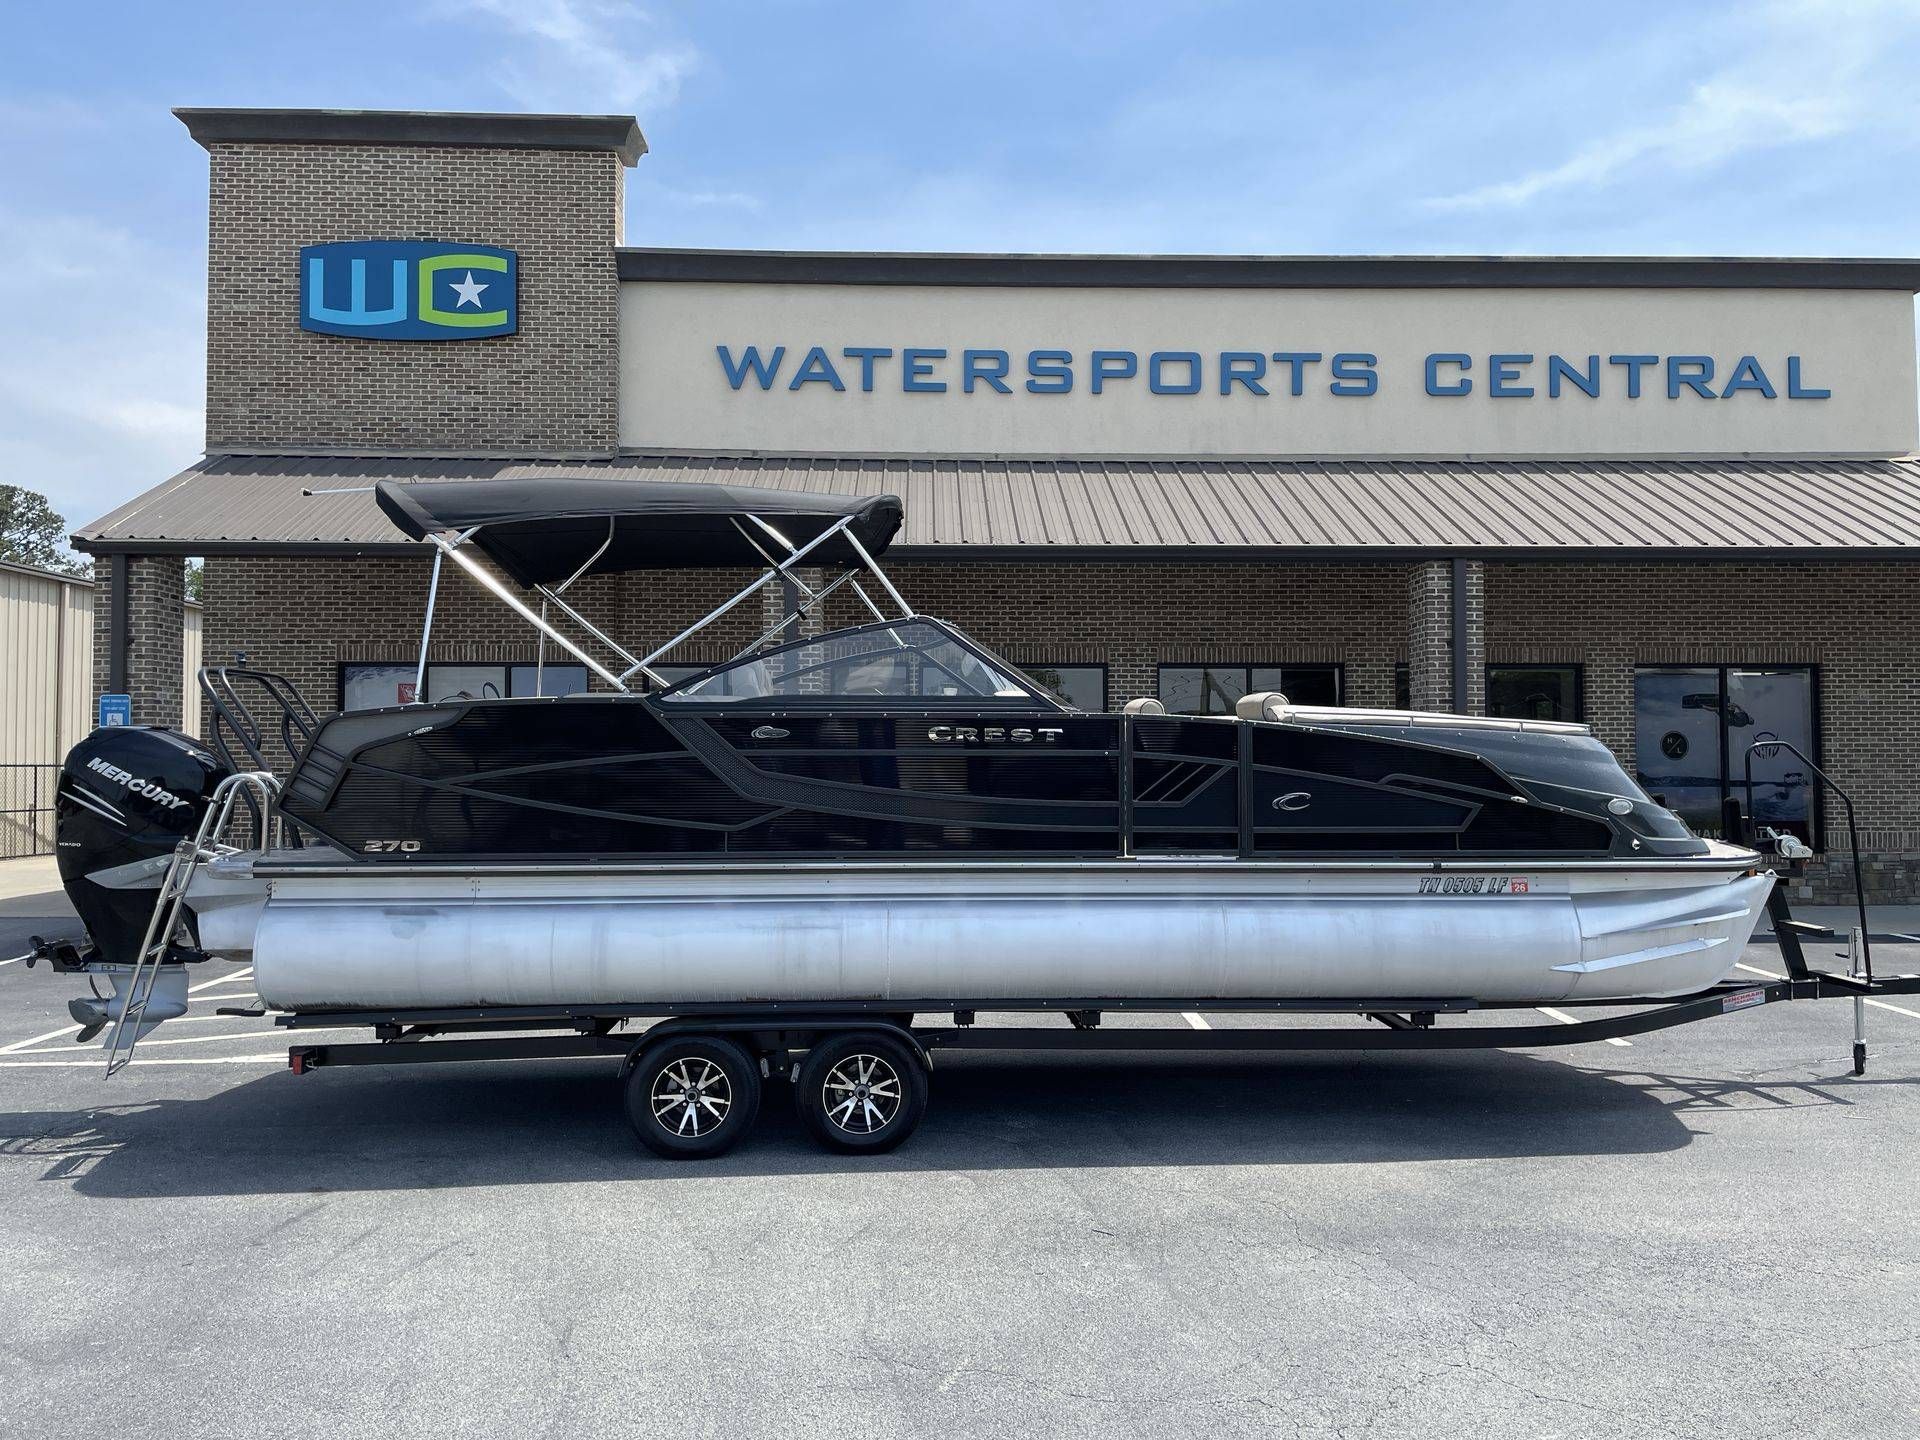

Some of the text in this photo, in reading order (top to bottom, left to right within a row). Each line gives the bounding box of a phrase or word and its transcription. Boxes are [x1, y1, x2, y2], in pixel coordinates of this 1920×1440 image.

[309, 254, 508, 328] WC
[716, 345, 1832, 400] WATERSPORTS CENTRAL
[927, 726, 1064, 743] CREST
[87, 757, 190, 810] MERCURY
[363, 840, 421, 852] 270
[1419, 877, 1509, 893] TN 0505 LF
[1514, 883, 1526, 892] 26
